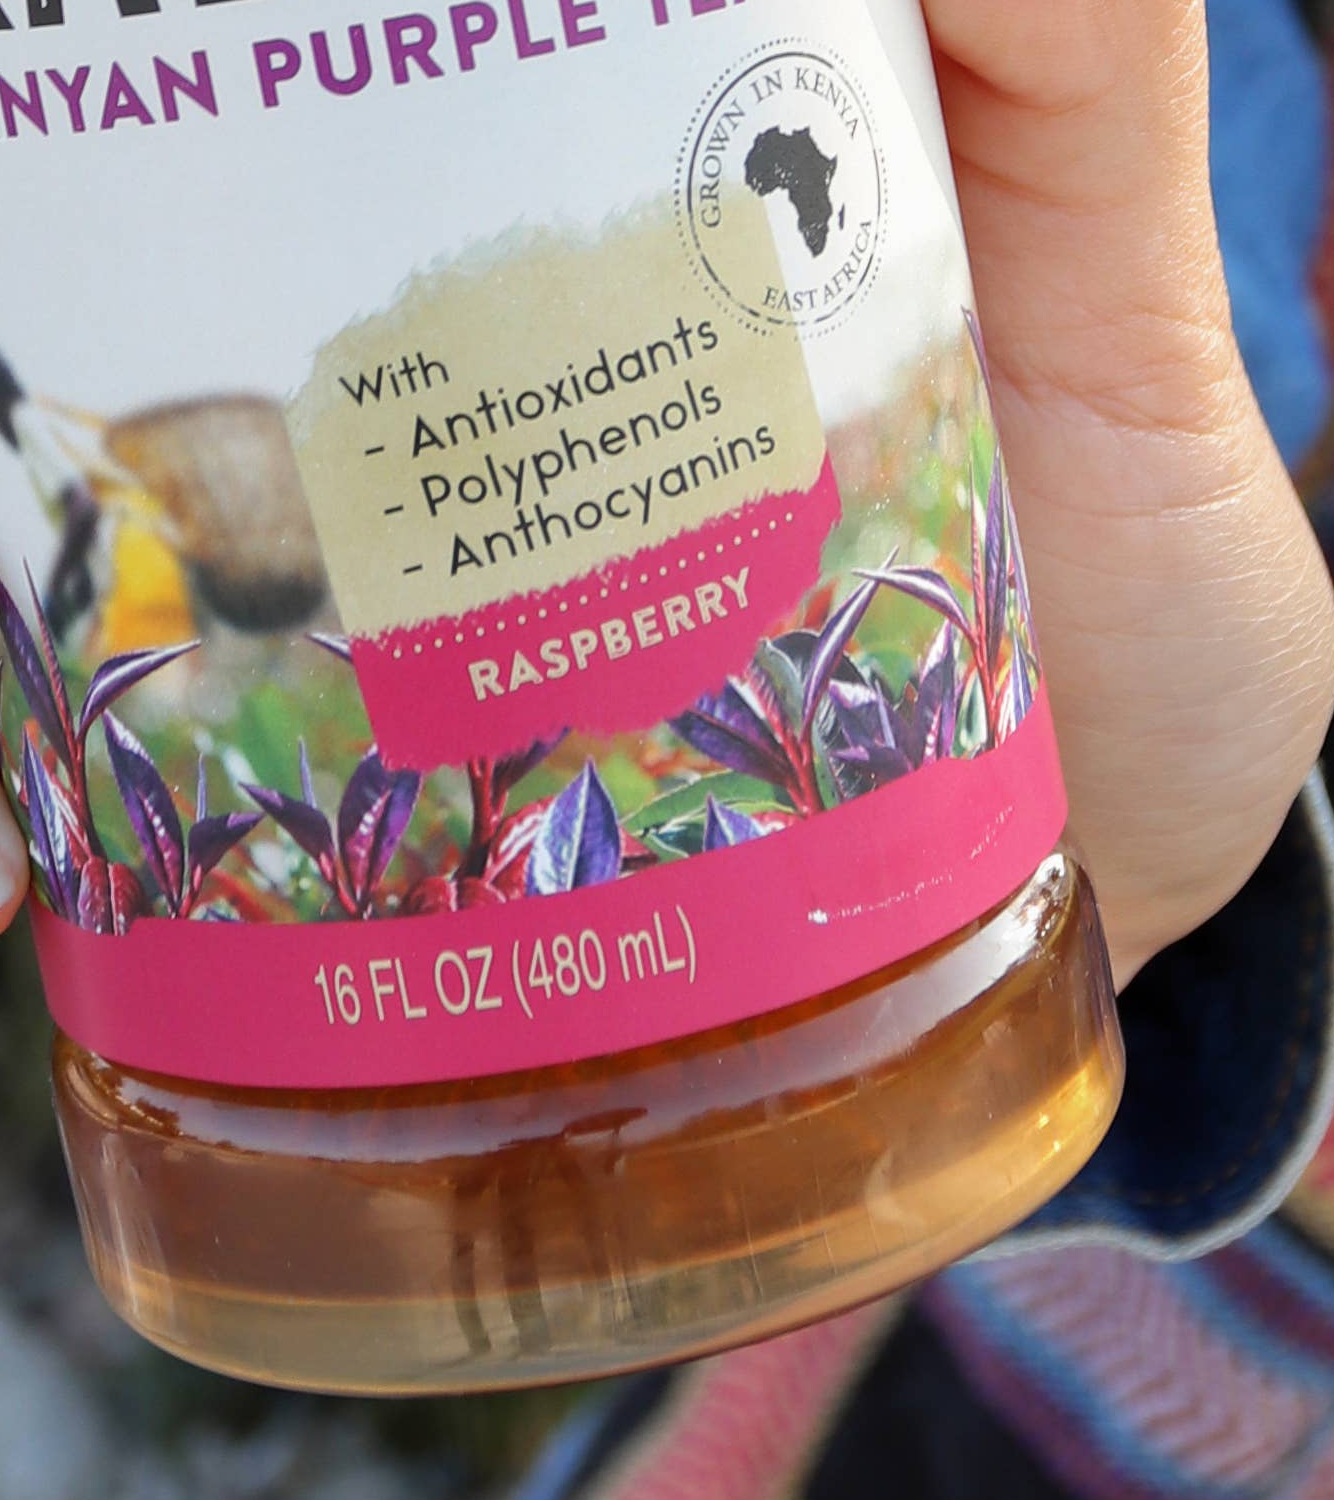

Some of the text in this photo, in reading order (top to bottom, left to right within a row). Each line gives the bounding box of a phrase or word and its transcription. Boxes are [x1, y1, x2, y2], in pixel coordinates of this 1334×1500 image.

[700, 67, 860, 228] GROWN IN KENYA
[763, 219, 873, 313] EAST AFRICA
[338, 351, 449, 407] With
[411, 317, 719, 459] Antioxidants
[421, 379, 722, 517] Polyphenols
[449, 425, 776, 577] Anthocyanins
[467, 567, 751, 701] RASPBERRY
[314, 904, 697, 1025] 16 FL OZ (480 mL)
